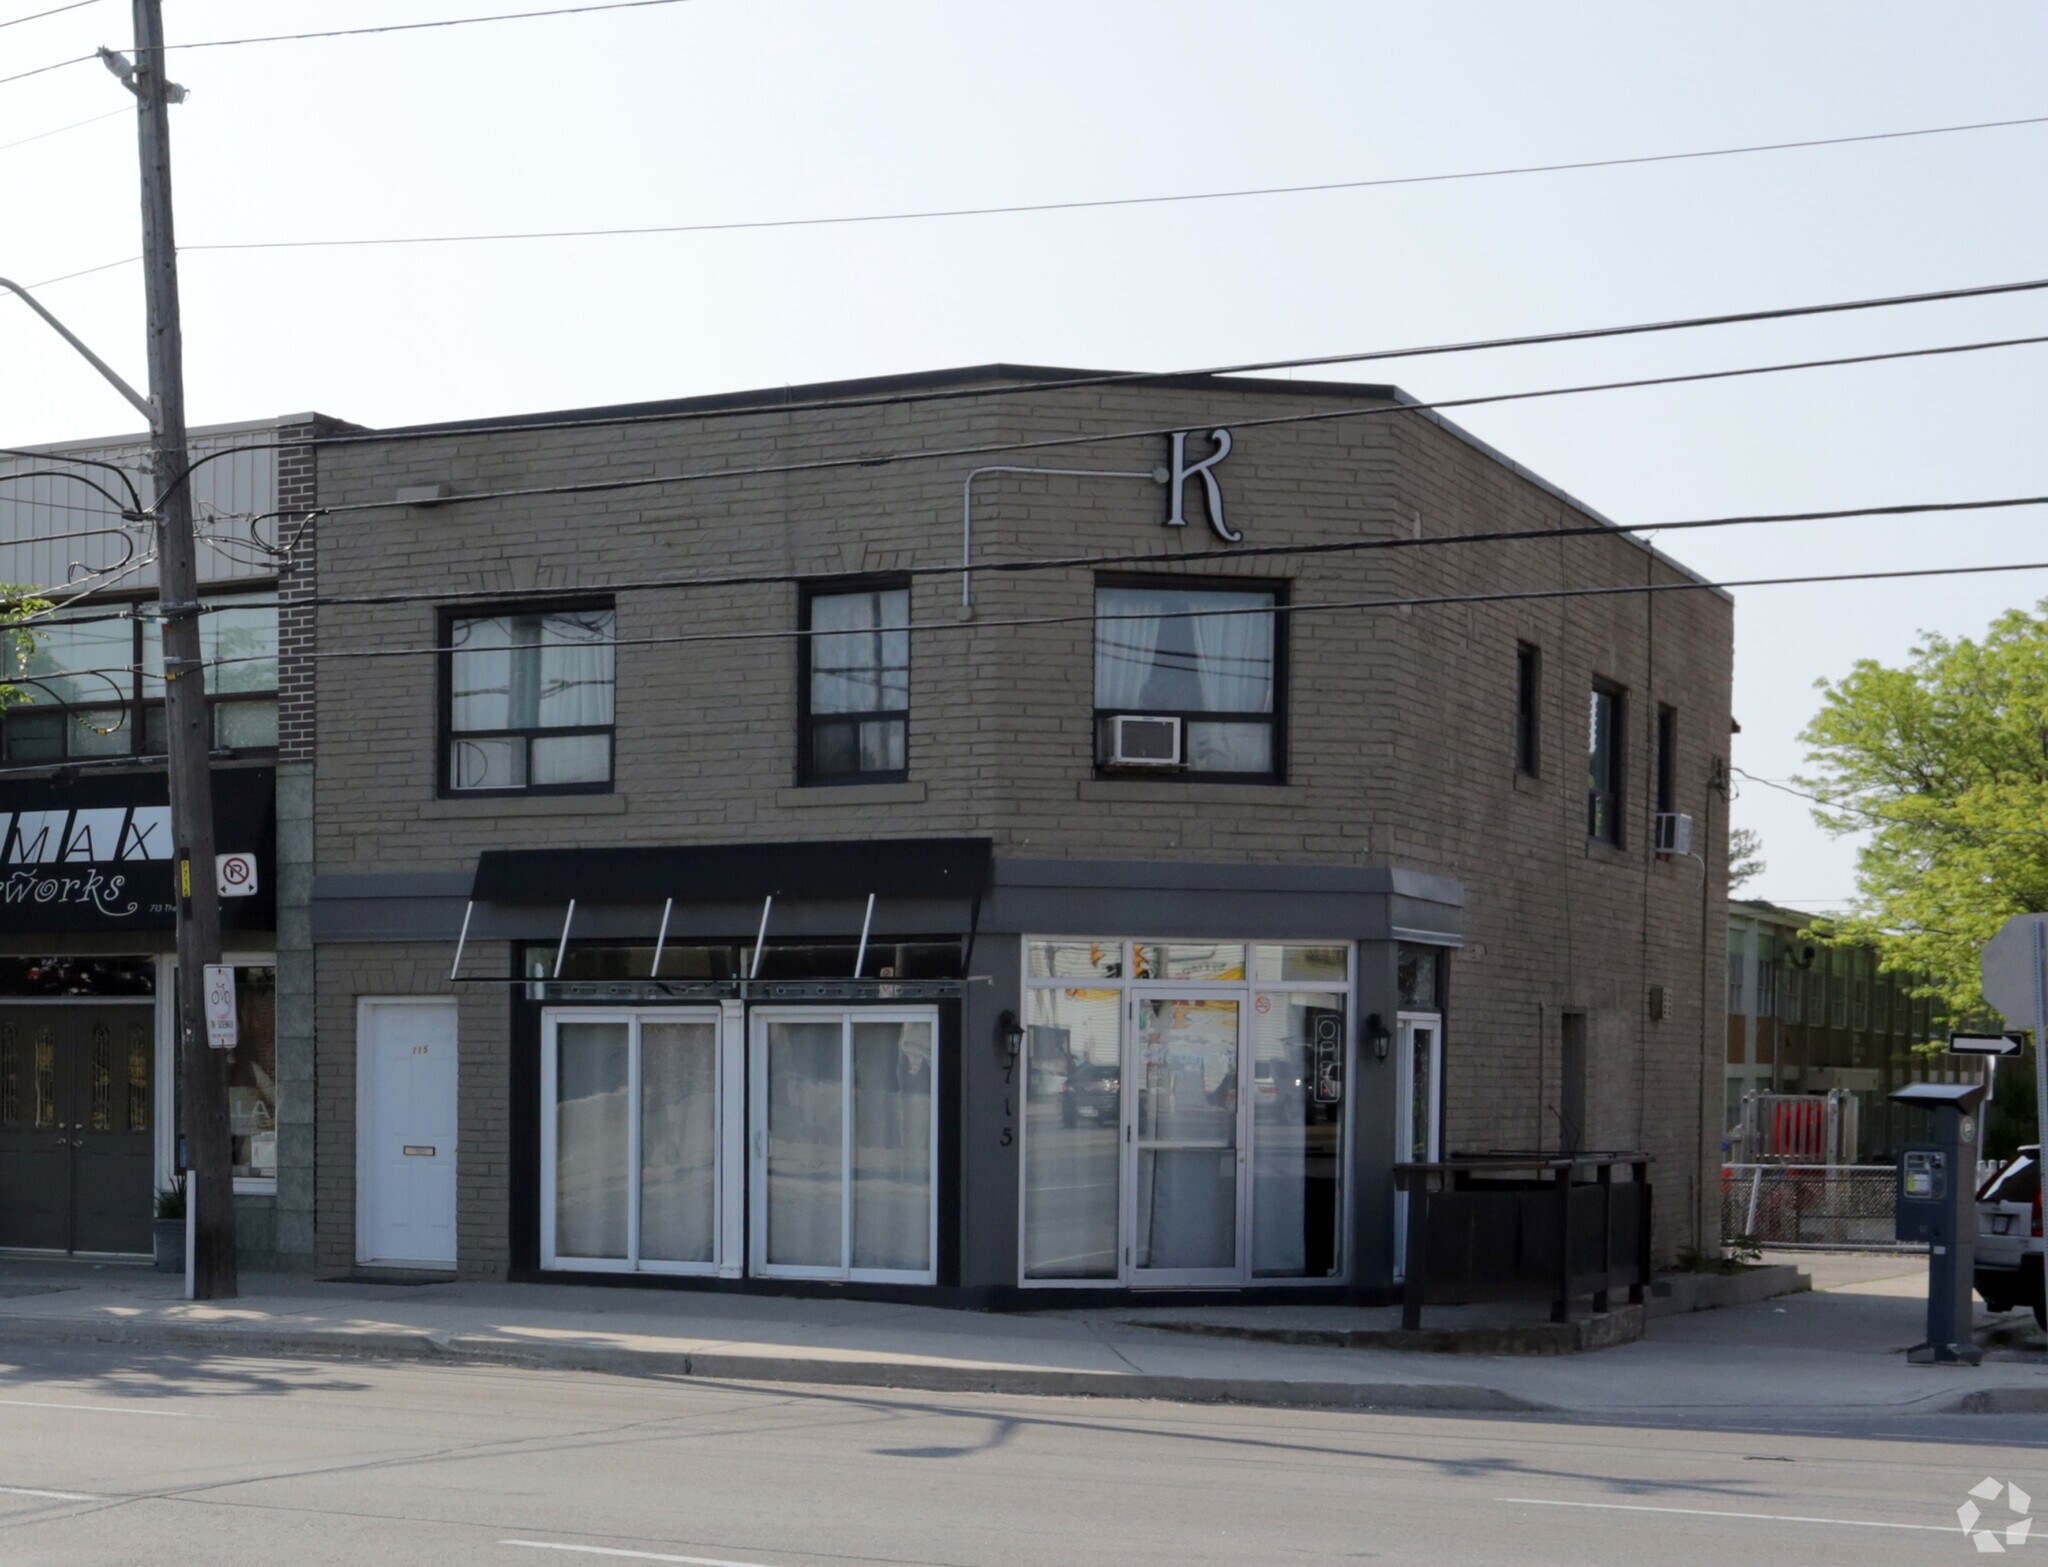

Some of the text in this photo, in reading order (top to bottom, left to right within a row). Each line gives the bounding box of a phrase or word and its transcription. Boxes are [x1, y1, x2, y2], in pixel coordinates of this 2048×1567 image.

[1165, 427, 1243, 543] K
[0, 868, 138, 917] works
[1318, 1019, 1337, 1098] OPEN
[1000, 1059, 1013, 1147] 715
